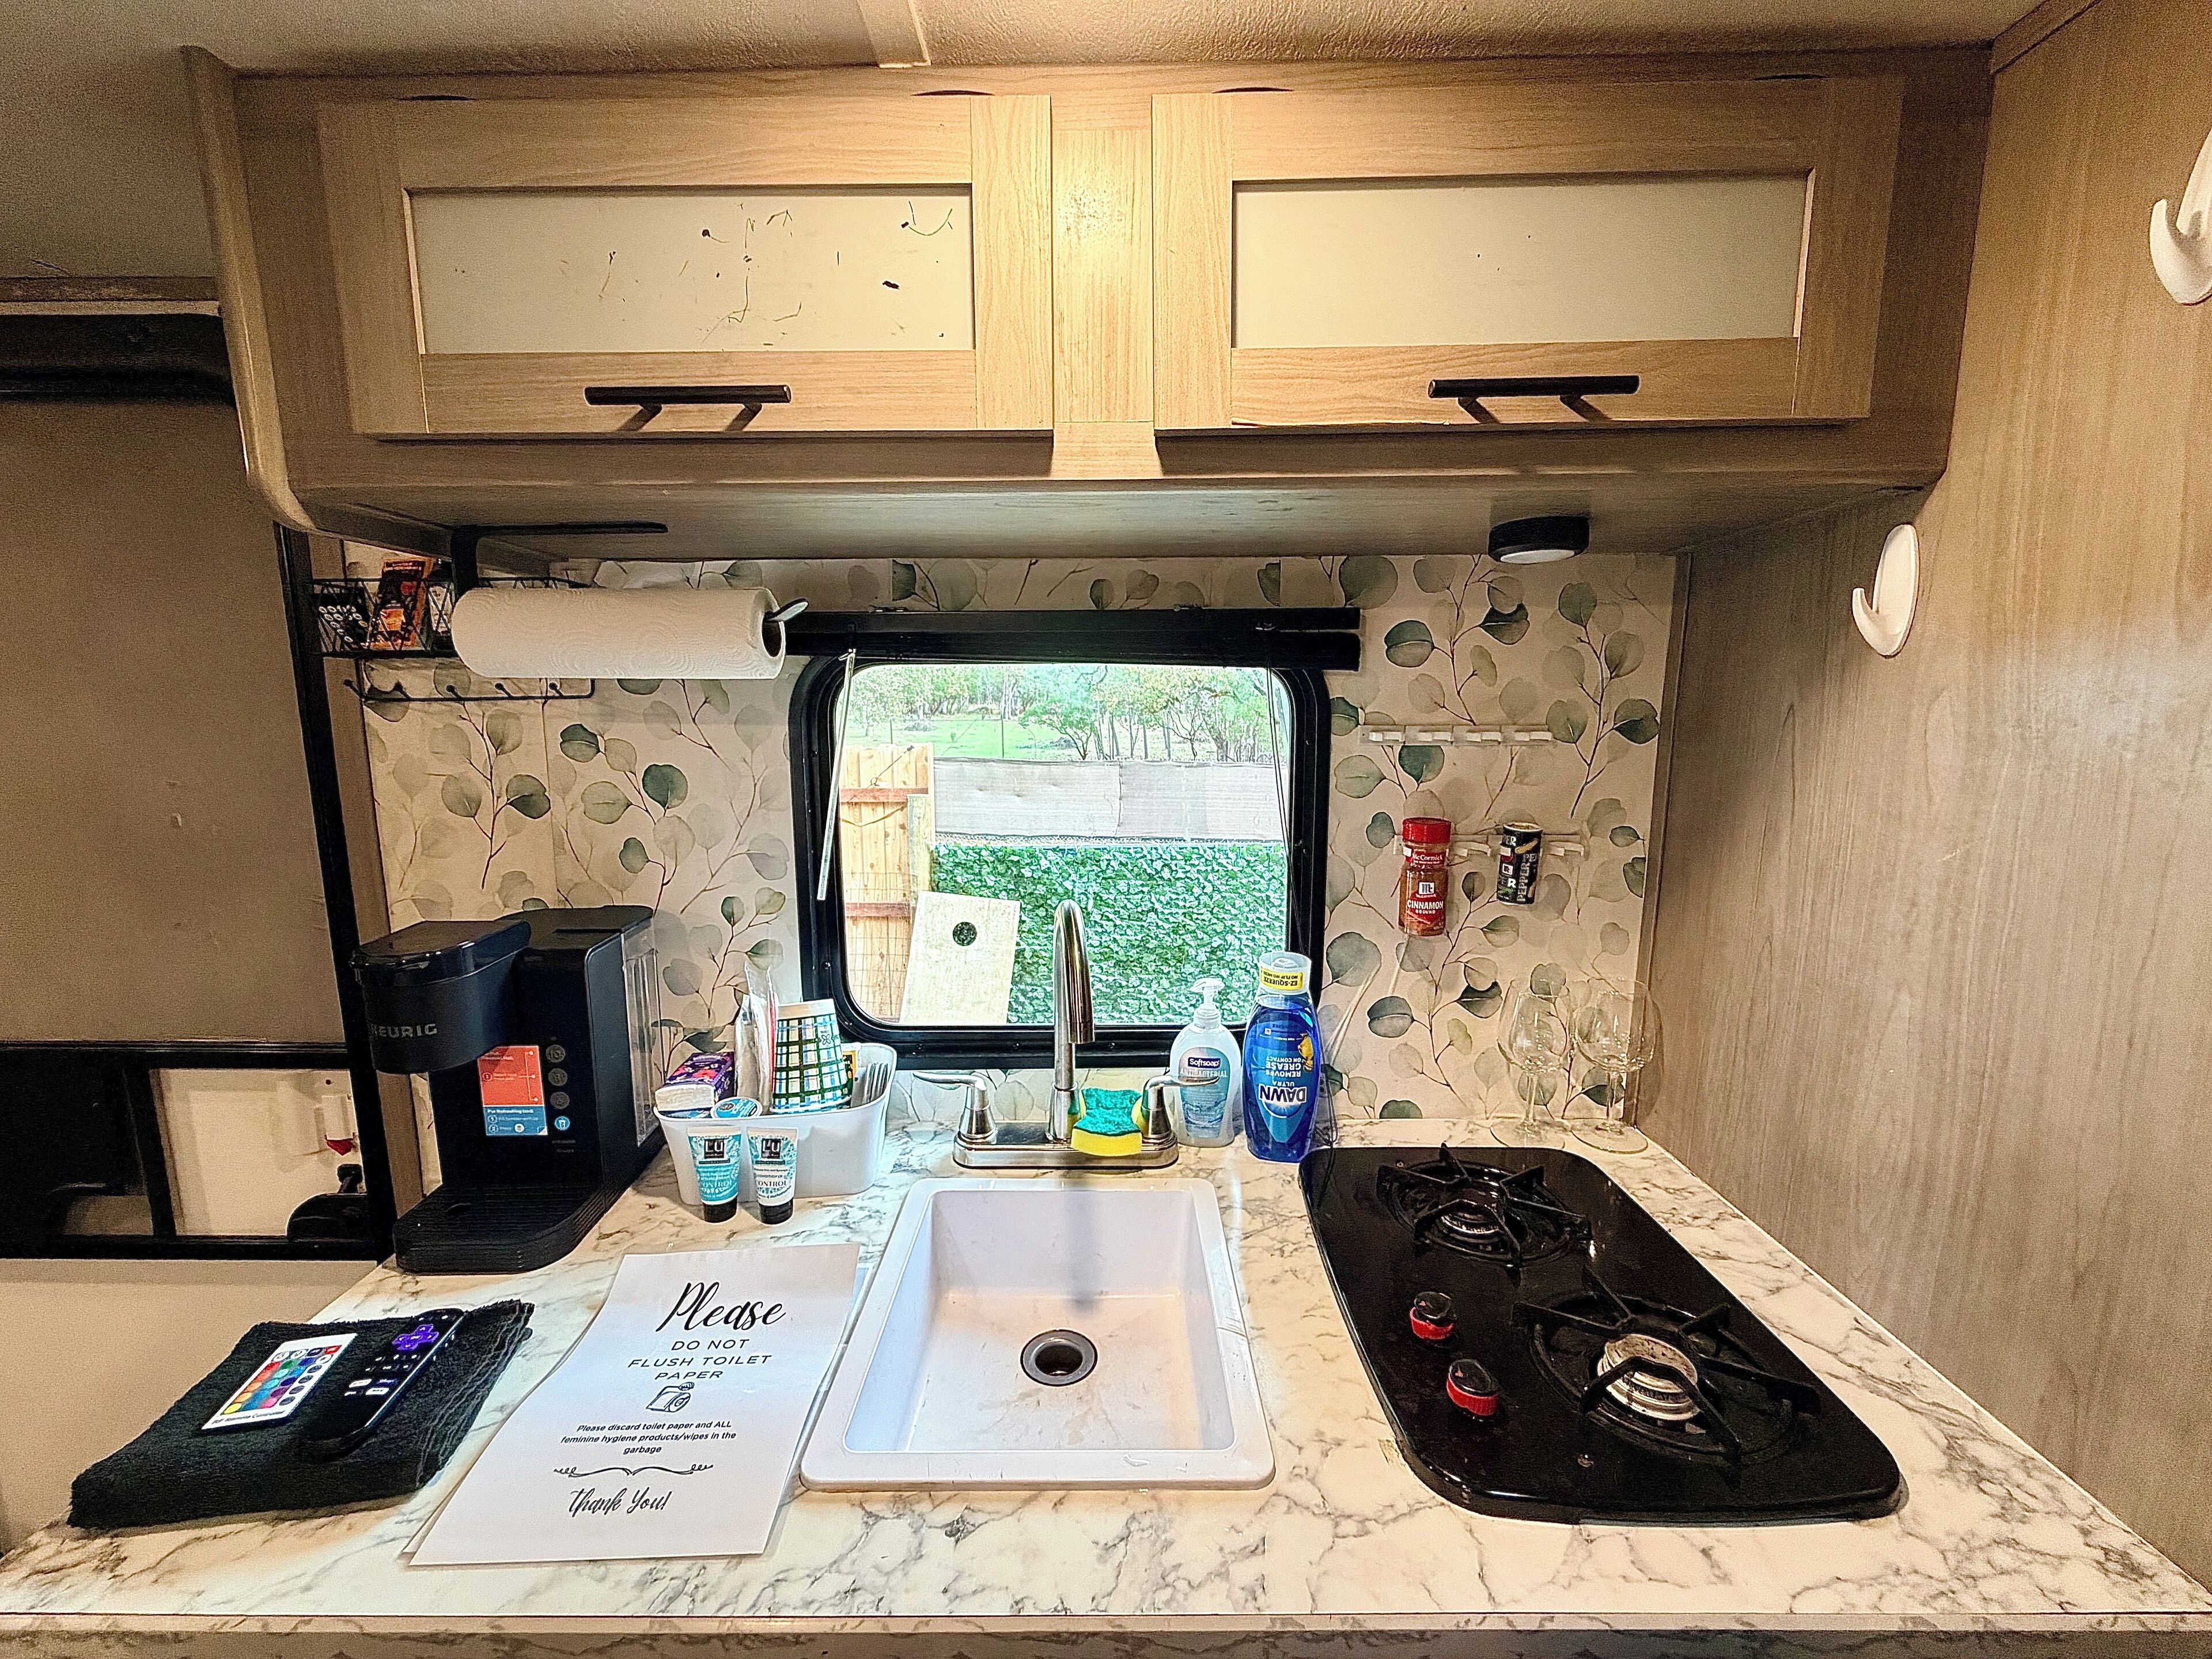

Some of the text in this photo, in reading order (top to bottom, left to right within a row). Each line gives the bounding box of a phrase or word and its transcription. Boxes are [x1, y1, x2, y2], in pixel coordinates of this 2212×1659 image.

[1412, 853, 1442, 861] McCormick
[1517, 862, 1530, 902] PEPPER
[1407, 899, 1444, 910] CINNAMON
[1263, 976, 1298, 986] EZ-SQUEEZE
[1190, 1058, 1219, 1067] Softsoap
[1266, 1060, 1301, 1070] GREASE
[1180, 1068, 1228, 1078] ANTIBACTERIAL
[1265, 1069, 1301, 1077] REMOVES
[1259, 1085, 1306, 1103] DAWN
[656, 1282, 786, 1332] Please
[671, 1339, 750, 1351] DO NOT
[628, 1355, 772, 1368] FLUSH TOILET
[654, 1370, 724, 1380] PAPER
[608, 1423, 641, 1431] discard
[560, 1435, 599, 1444] feminine
[601, 1435, 637, 1444] hygiene
[638, 1431, 709, 1442] products/wipes
[623, 1445, 662, 1455] garbage
[569, 1486, 672, 1517] Thank You!
